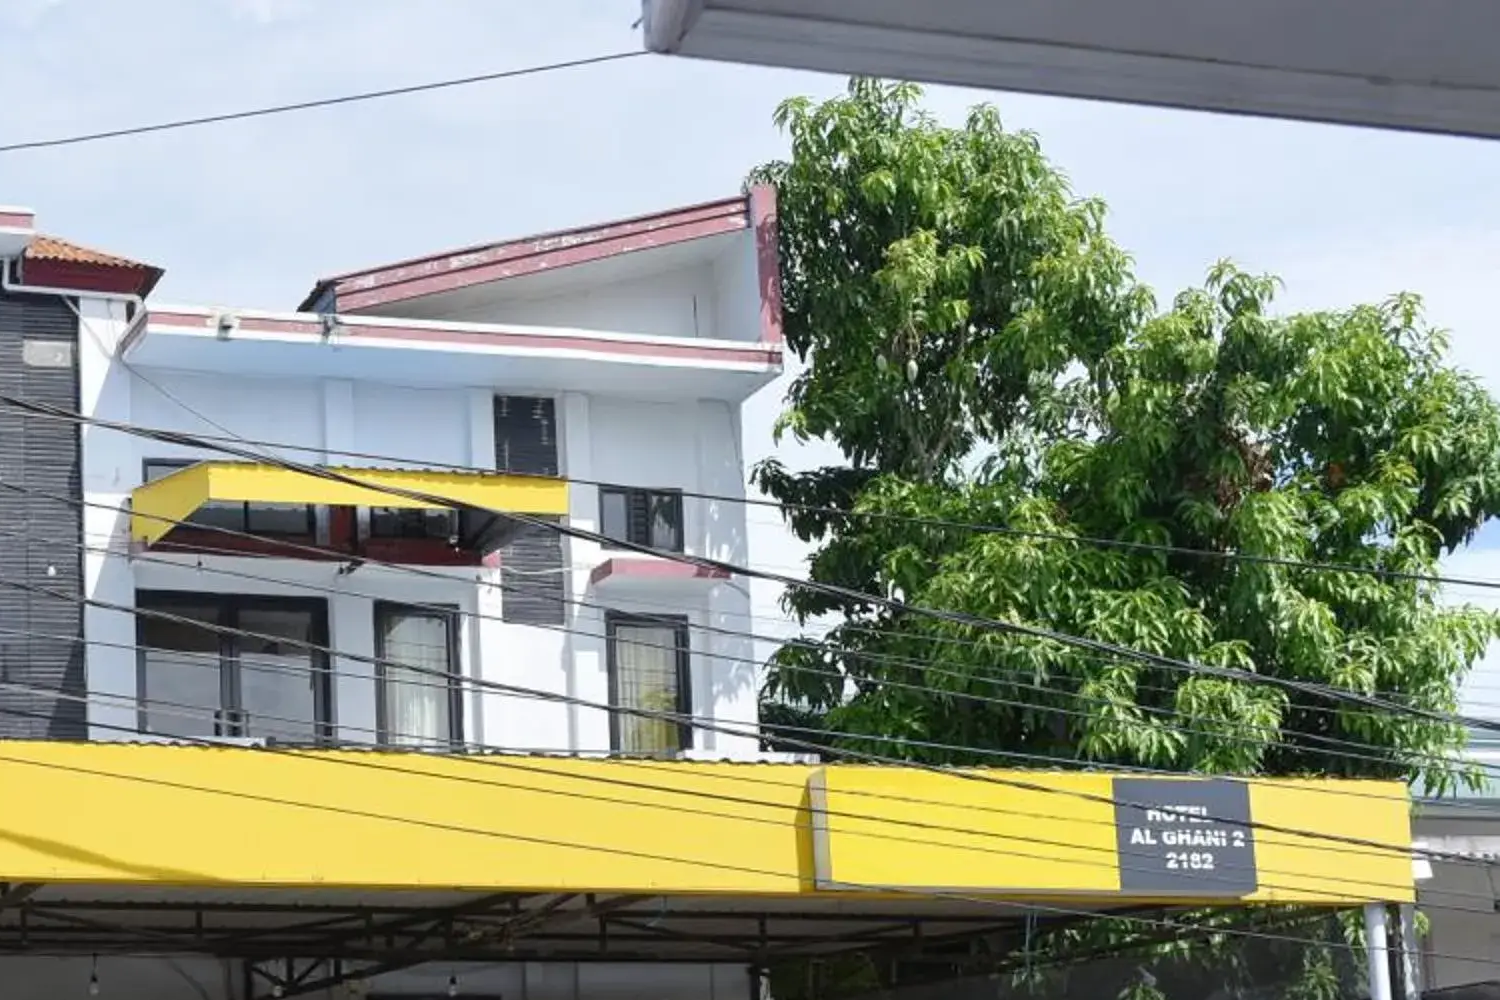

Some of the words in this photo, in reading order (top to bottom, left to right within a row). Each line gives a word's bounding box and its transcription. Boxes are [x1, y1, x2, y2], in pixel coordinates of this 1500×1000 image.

[1147, 806, 1213, 822] HOTEL
[1130, 828, 1157, 844] AL
[1162, 830, 1227, 847] GHANI
[1232, 831, 1245, 847] 2
[1166, 852, 1215, 869] 2182
